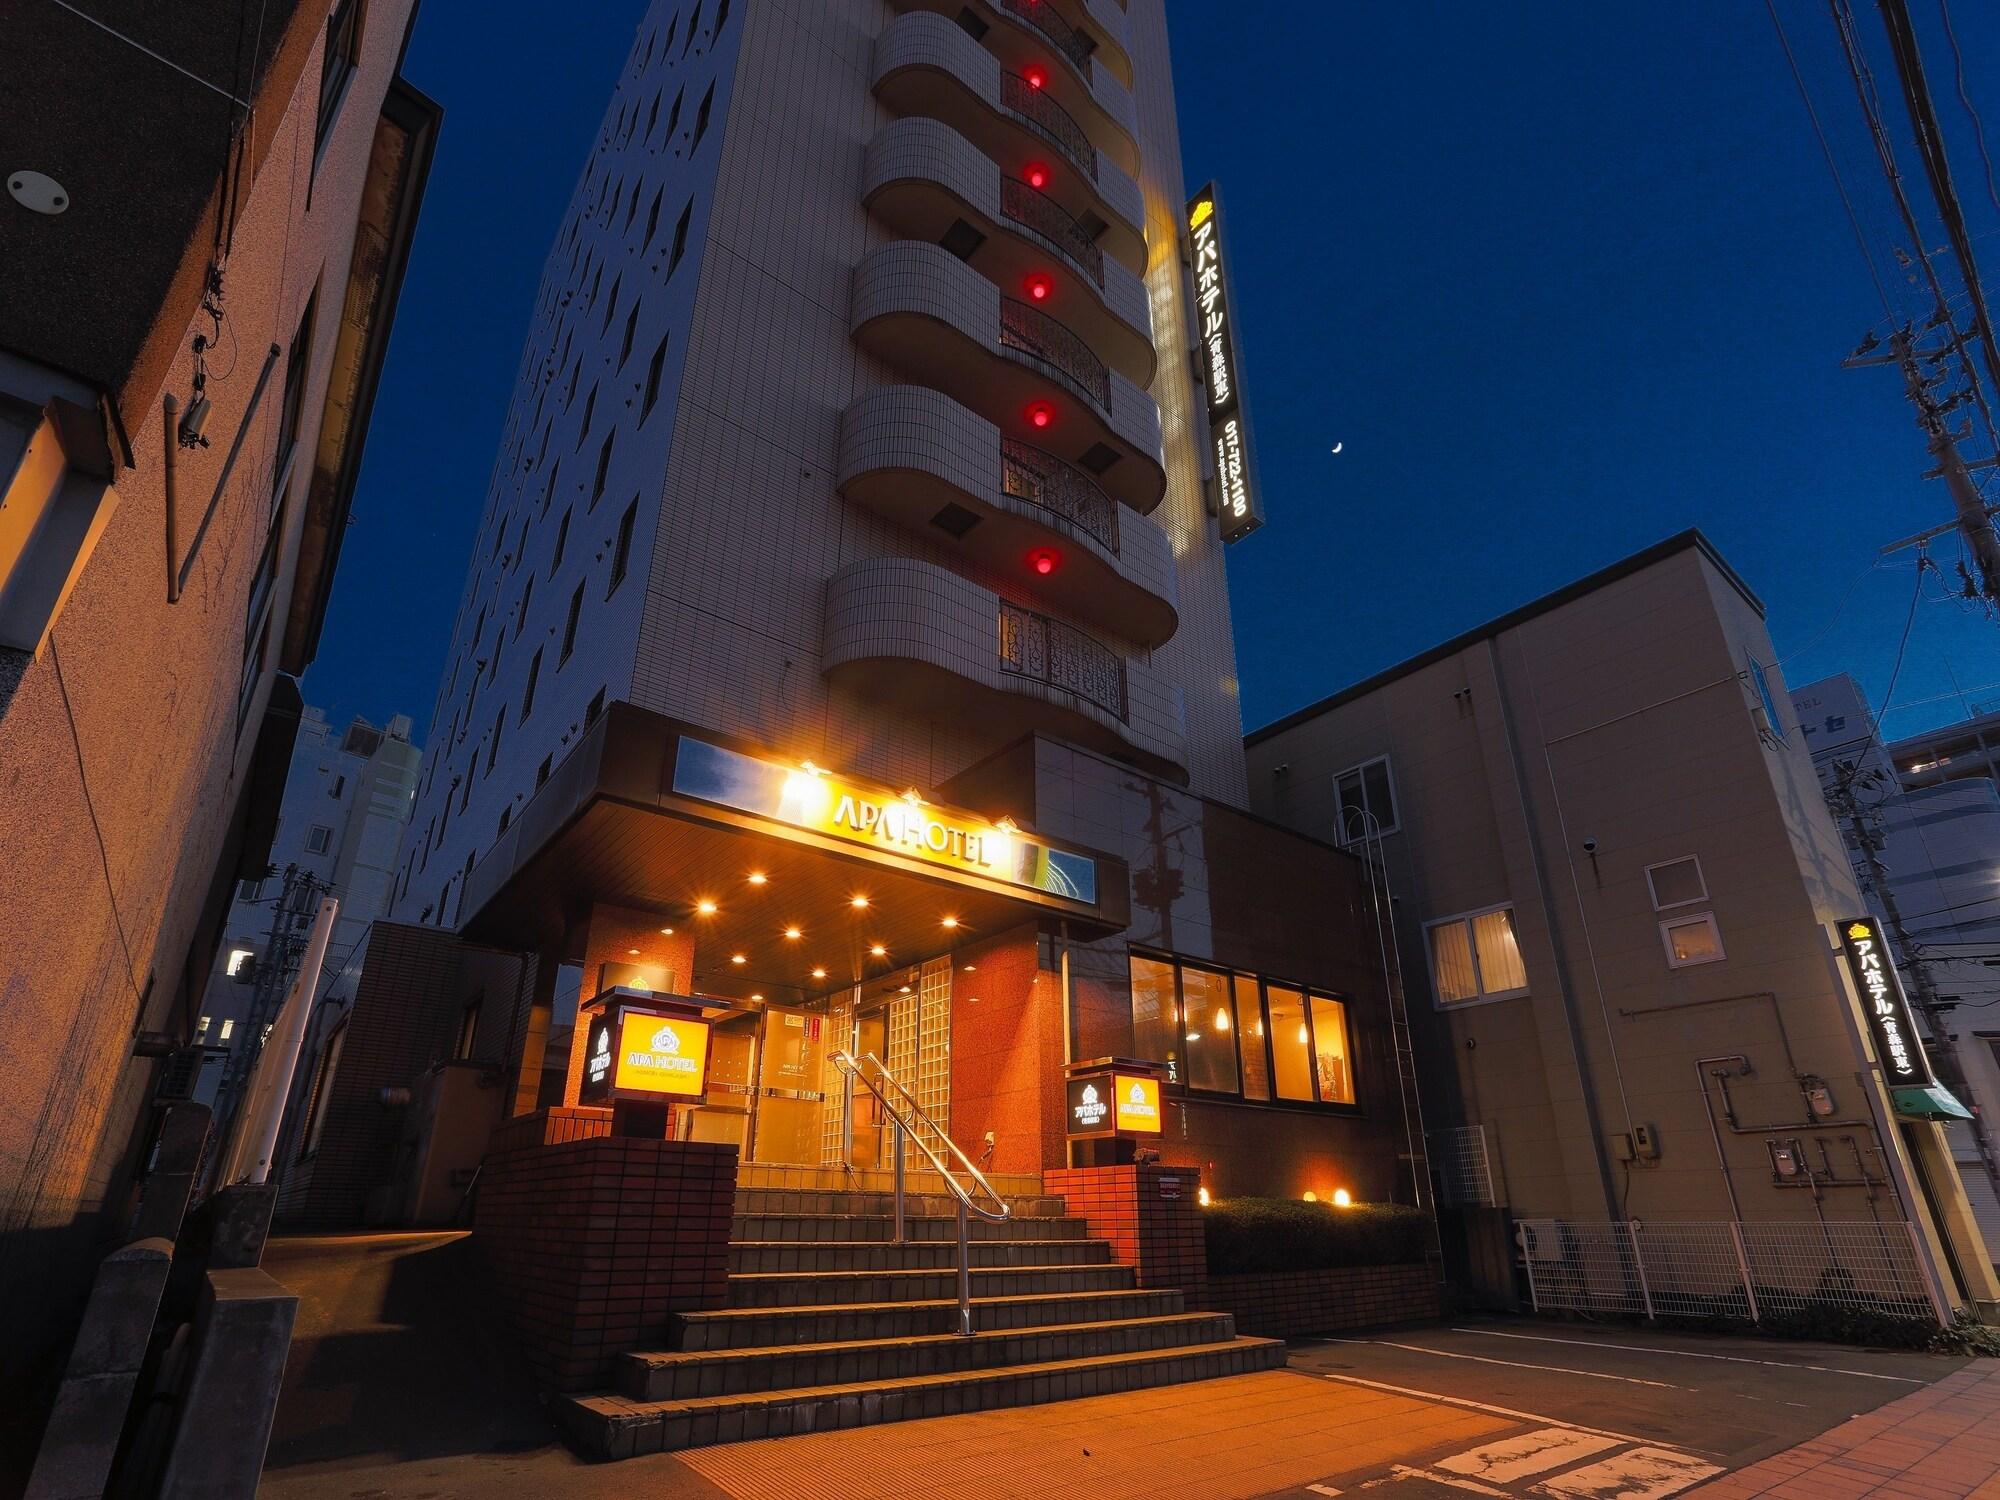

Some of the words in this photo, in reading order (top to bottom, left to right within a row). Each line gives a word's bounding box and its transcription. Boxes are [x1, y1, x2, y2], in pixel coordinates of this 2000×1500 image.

[833, 794, 894, 841] APA
[900, 810, 991, 867] HOTEL
[627, 1052, 654, 1067] APA
[1074, 1102, 1107, 1118] アパホテル
